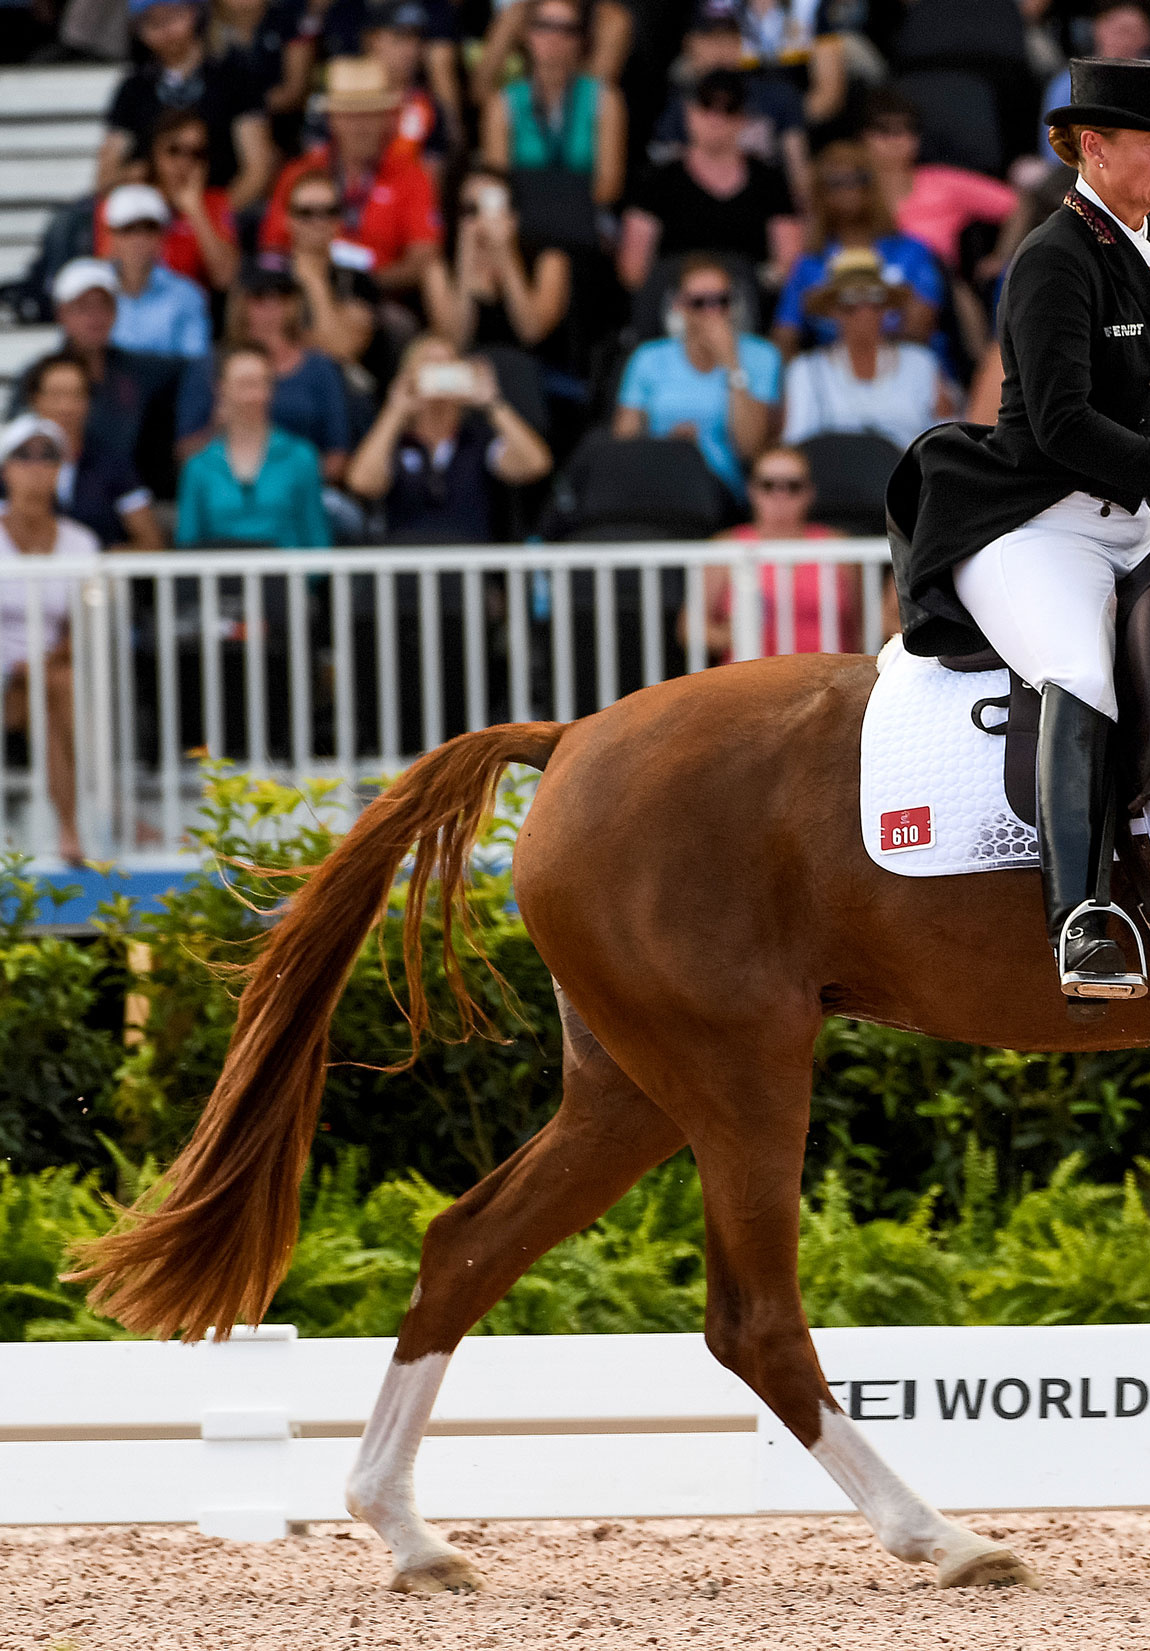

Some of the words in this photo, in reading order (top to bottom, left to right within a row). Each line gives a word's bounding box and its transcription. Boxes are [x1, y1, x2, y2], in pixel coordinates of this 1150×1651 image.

[1103, 323, 1145, 338] FENDT
[892, 824, 919, 846] 610
[934, 1375, 1149, 1421] WORLD
